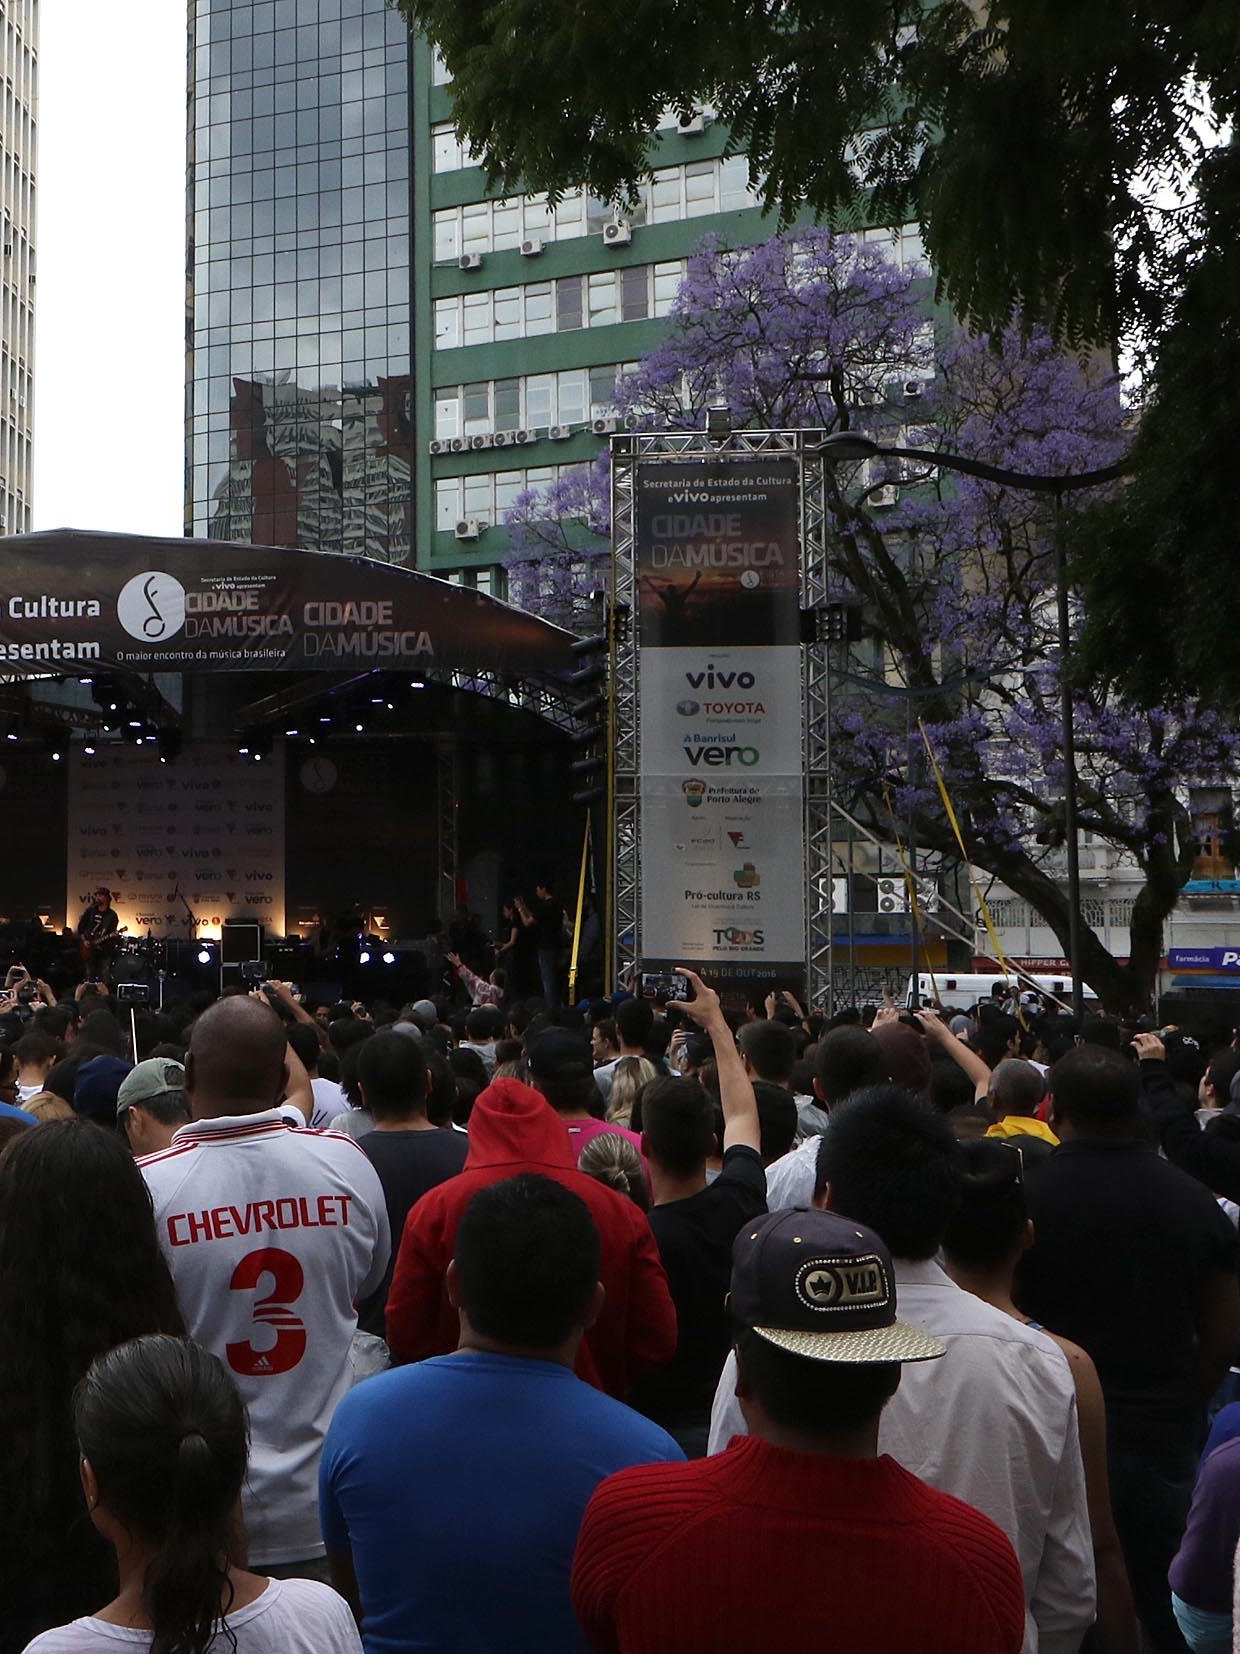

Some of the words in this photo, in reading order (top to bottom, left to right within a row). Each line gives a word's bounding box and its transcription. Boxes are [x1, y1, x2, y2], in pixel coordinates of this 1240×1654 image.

[643, 478, 691, 488] Secretaria
[707, 477, 740, 487] Estado
[756, 476, 792, 485] Cultura
[673, 489, 709, 502] vivo
[710, 494, 767, 503] apresentam
[651, 513, 742, 538] CIDADE
[216, 582, 235, 590] vivo
[10, 595, 100, 619] Cultura
[185, 590, 259, 613] CIDADE
[303, 600, 393, 626] CIDADE
[116, 651, 124, 661] O
[126, 651, 152, 660] maior
[154, 650, 193, 660] encontro
[196, 650, 207, 659] da
[210, 649, 242, 659] música
[244, 648, 286, 658] brasileira
[685, 664, 755, 689] vivo
[703, 702, 765, 714] TOYOTA
[693, 733, 736, 743] Banrisul
[683, 746, 760, 767] vero
[685, 890, 744, 900] Pró-cultura
[747, 891, 761, 901] RS
[1175, 954, 1210, 963] farmácia
[167, 1195, 353, 1247] CHEVROLET
[226, 1247, 307, 1377] 3
